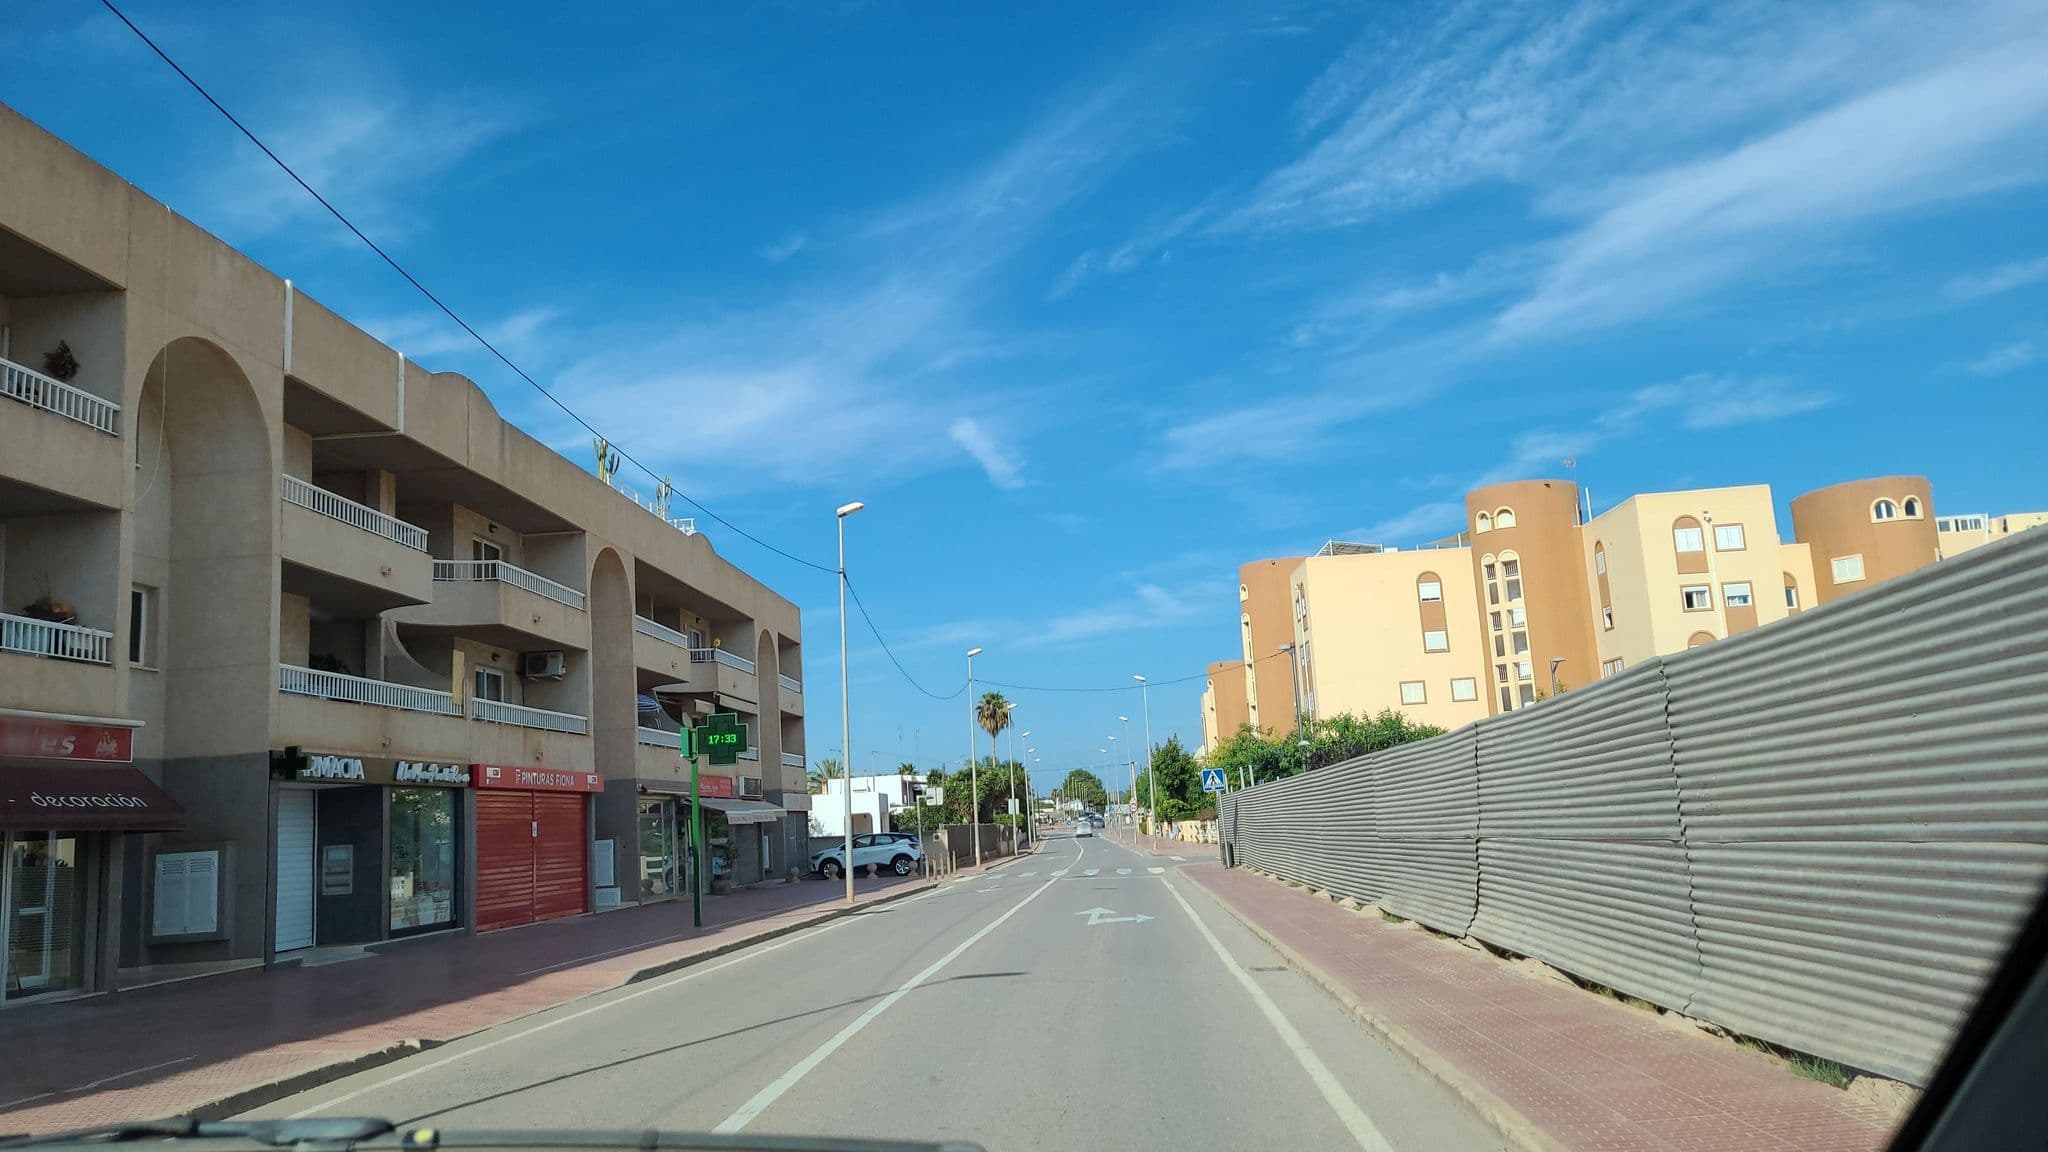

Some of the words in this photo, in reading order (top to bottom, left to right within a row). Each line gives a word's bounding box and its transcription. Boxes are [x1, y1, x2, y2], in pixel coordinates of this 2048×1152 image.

[708, 734, 737, 744] 17:33
[303, 756, 365, 779] RMACIA
[522, 771, 554, 787] PINTURAS
[556, 774, 575, 787] FIONA
[30, 791, 148, 808] decoración
